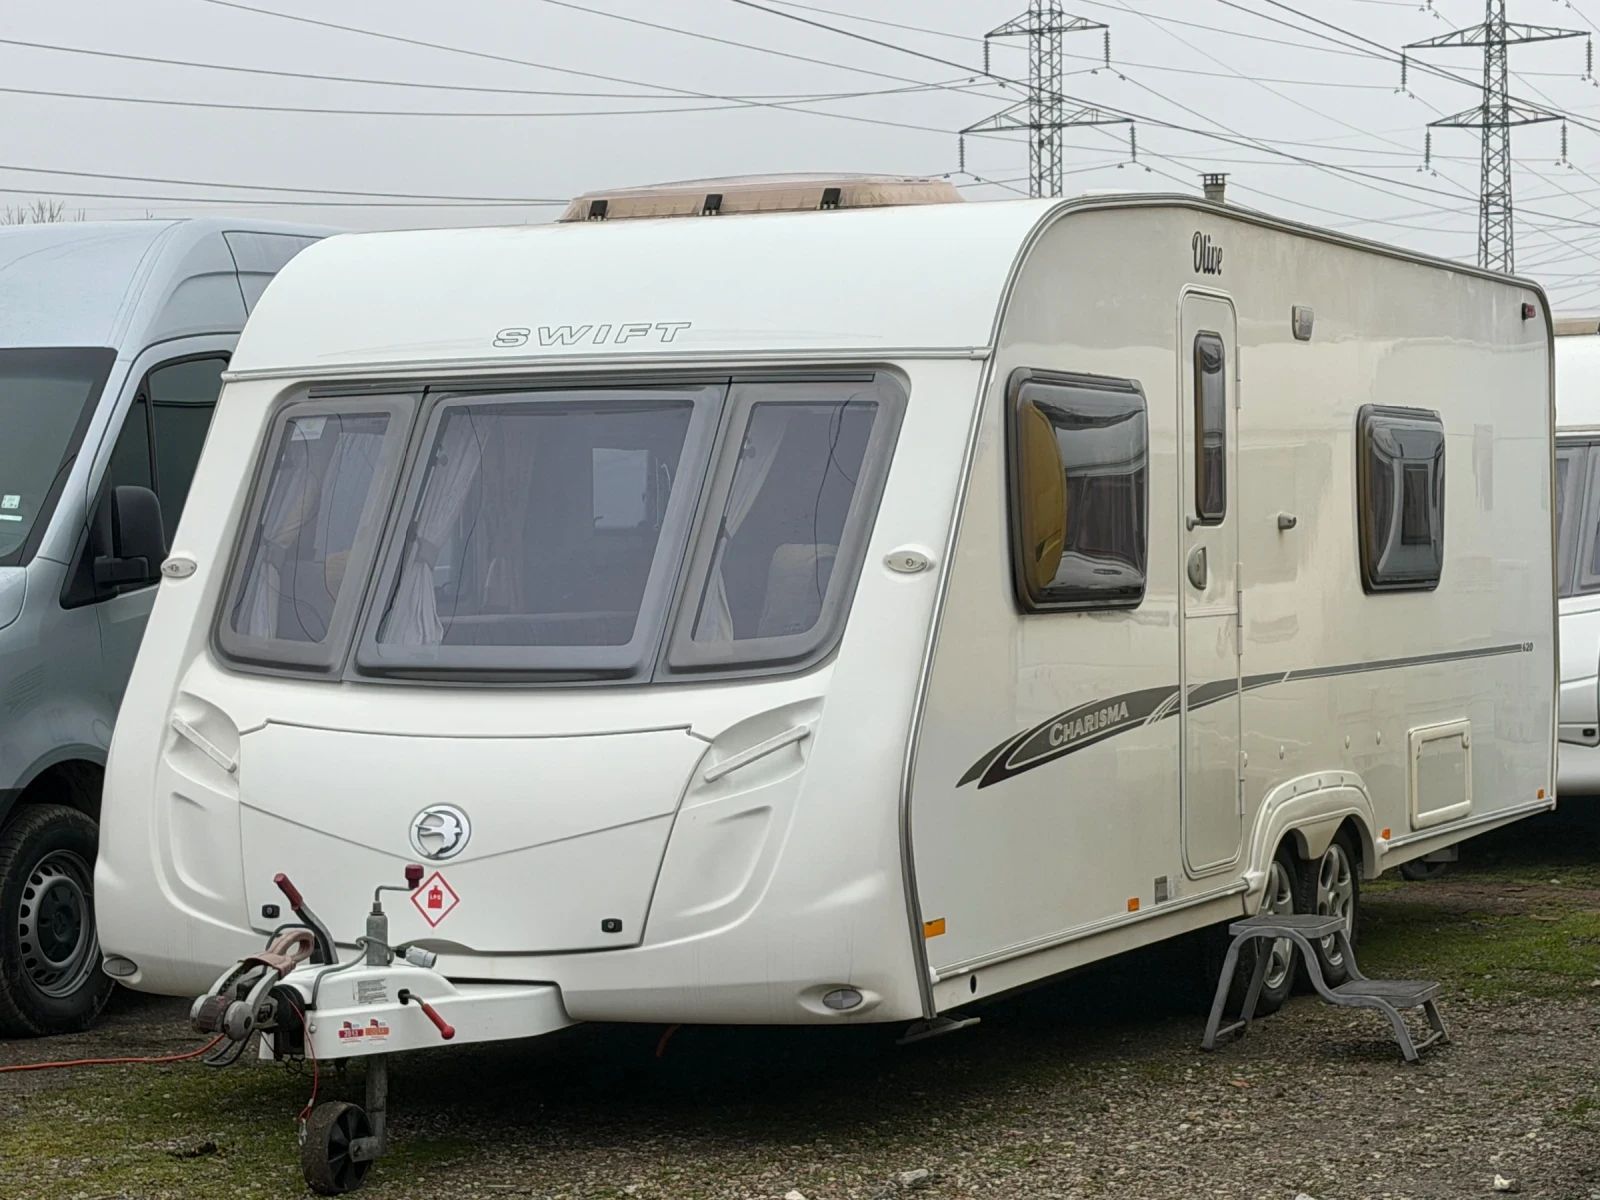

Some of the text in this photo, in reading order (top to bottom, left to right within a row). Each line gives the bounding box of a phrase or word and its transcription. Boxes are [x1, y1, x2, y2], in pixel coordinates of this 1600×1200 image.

[1192, 230, 1223, 276] Olive
[492, 322, 692, 348] SWIFT
[1522, 642, 1533, 652] 620
[1049, 701, 1129, 746] CHARISMA
[343, 1030, 359, 1038] 2013
